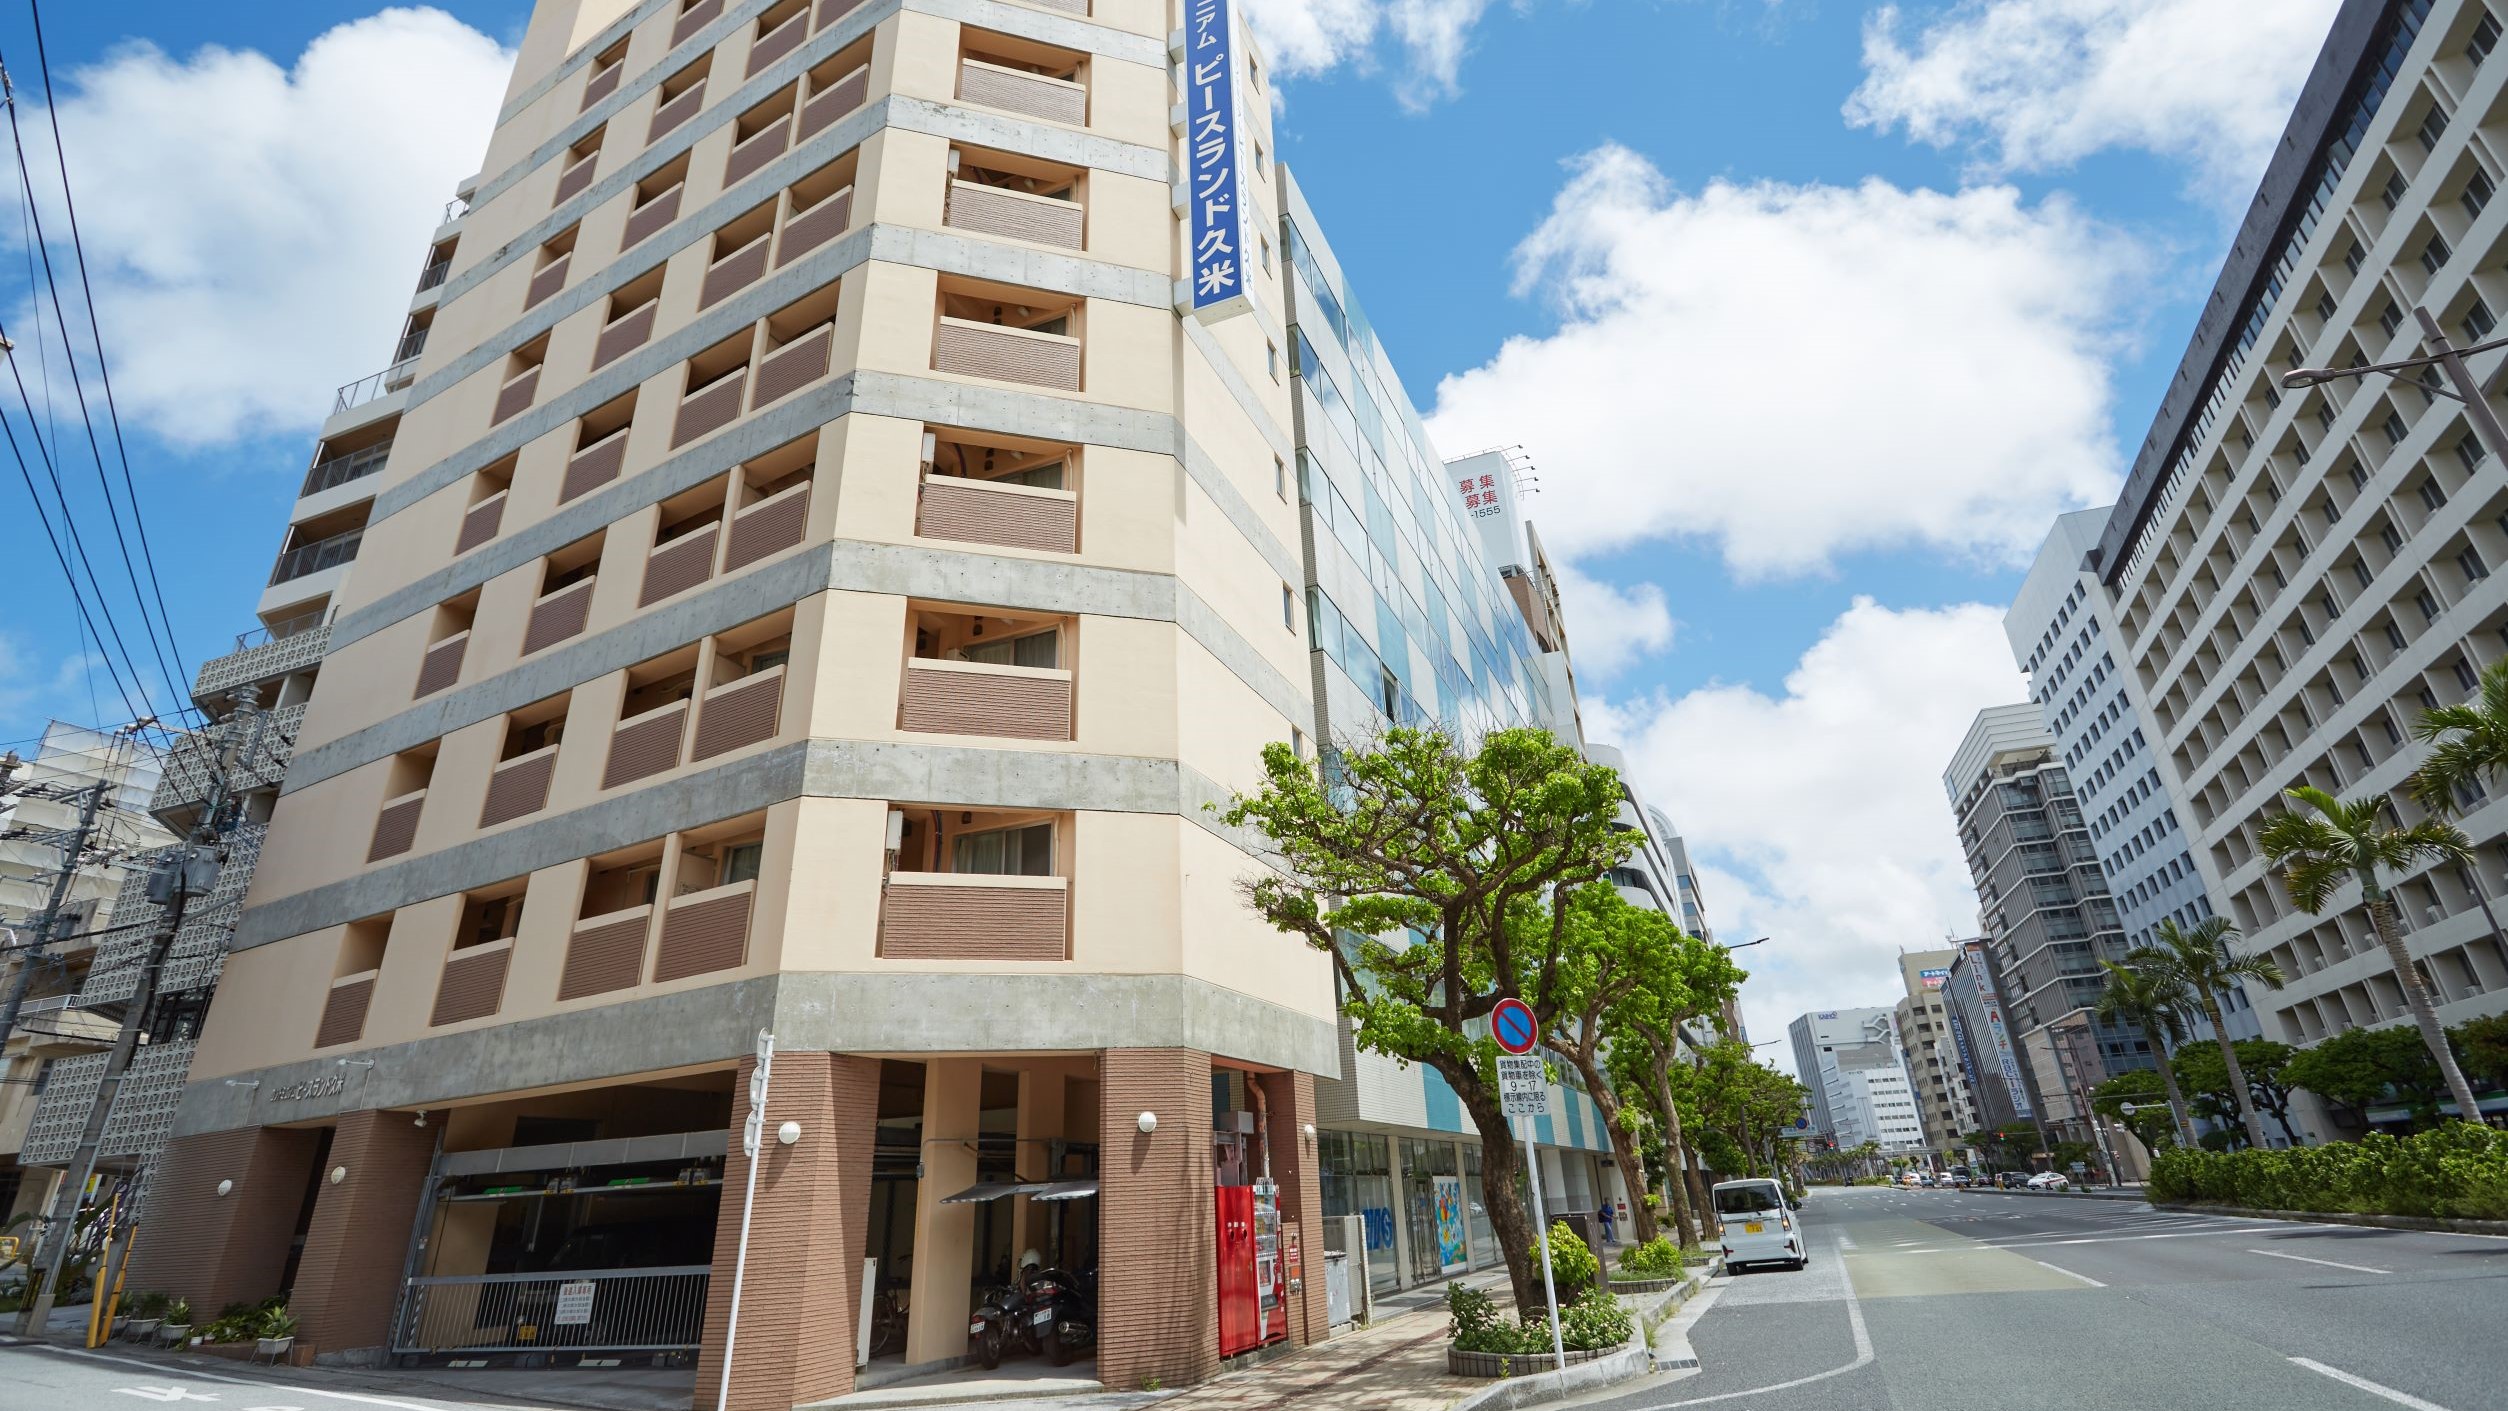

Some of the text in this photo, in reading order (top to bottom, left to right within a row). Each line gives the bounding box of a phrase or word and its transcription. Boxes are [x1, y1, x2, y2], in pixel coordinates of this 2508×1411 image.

[1195, 53, 1236, 298] ピースランド久米
[1459, 474, 1495, 494] 募集
[1465, 490, 1498, 510] 募集
[1500, 1060, 1541, 1070] 貨物集配中の
[1501, 1070, 1543, 1080] 貨物車を除く
[1508, 1103, 1545, 1113] ここから
